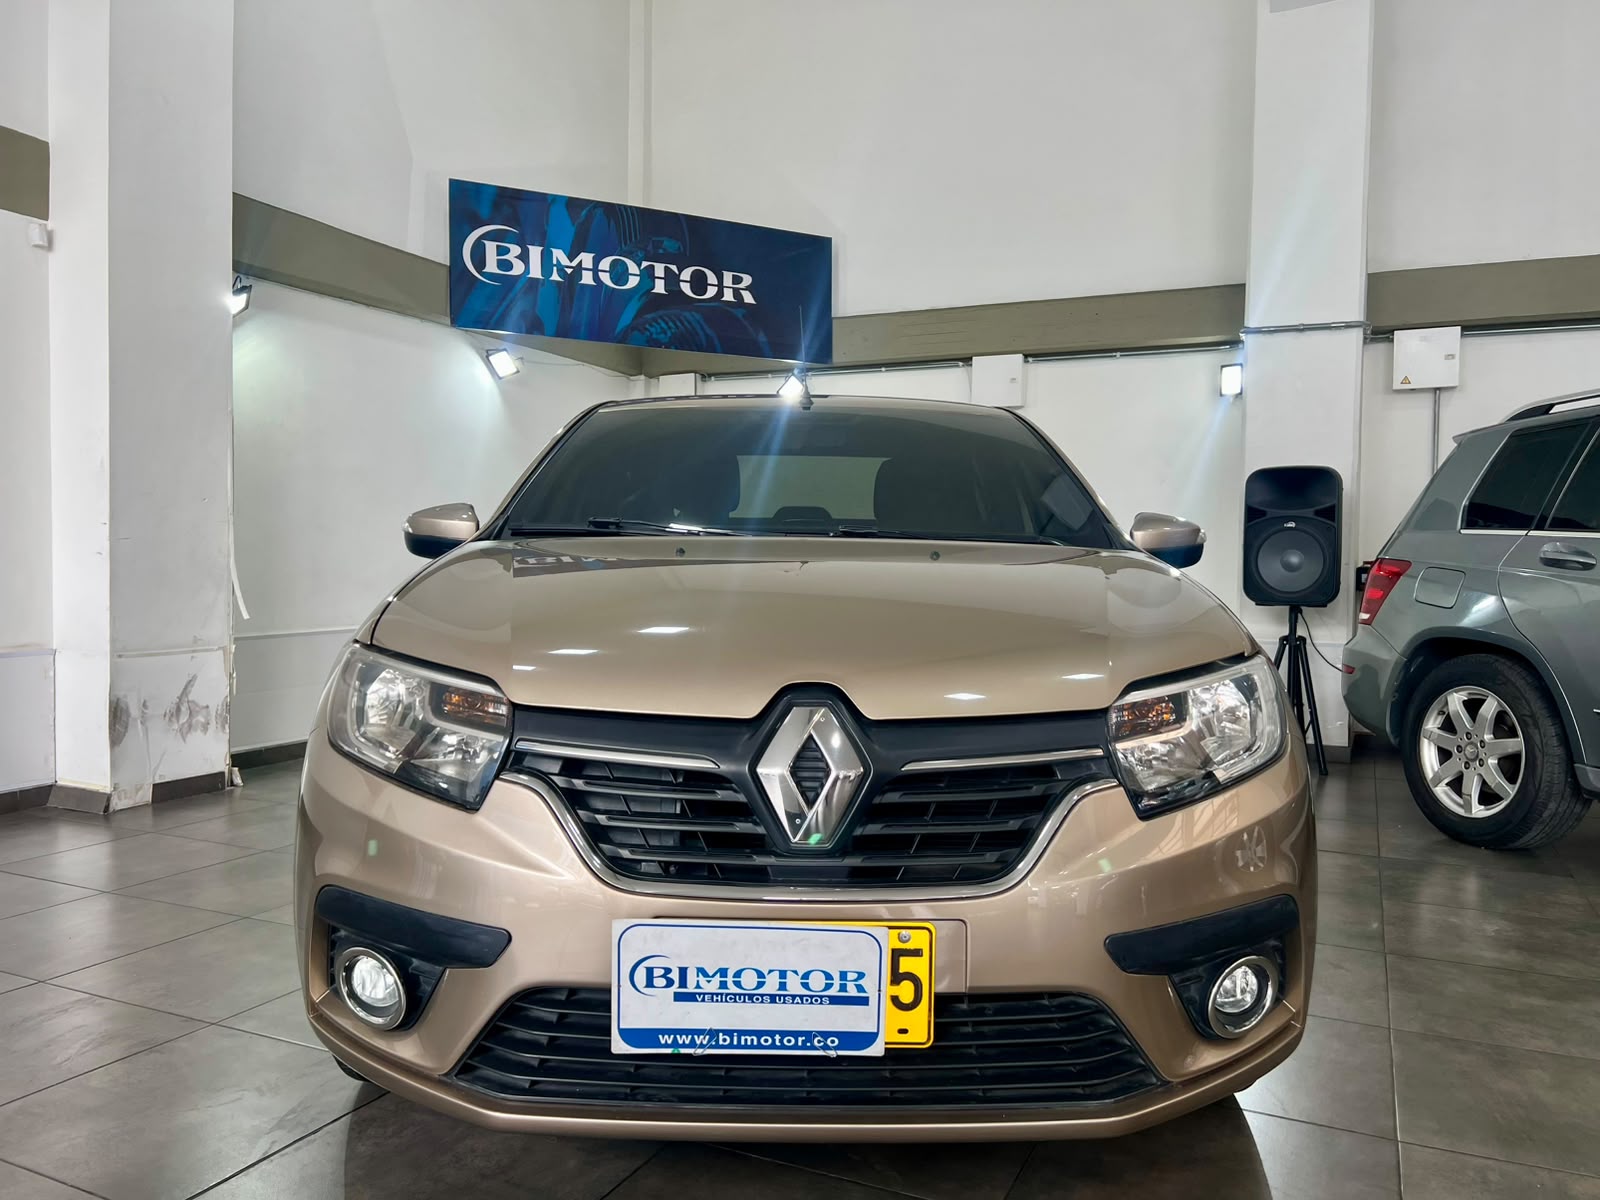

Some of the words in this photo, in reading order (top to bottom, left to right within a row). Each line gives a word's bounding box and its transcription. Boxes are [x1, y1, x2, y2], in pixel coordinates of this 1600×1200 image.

[480, 239, 758, 305] BIMOTOR
[643, 965, 869, 994] BIMOTOR
[889, 948, 924, 1012] 5
[695, 992, 771, 1005] VEHÍCULOS
[775, 995, 831, 1006] USADOS
[657, 1031, 840, 1049] www.bimotor.co
